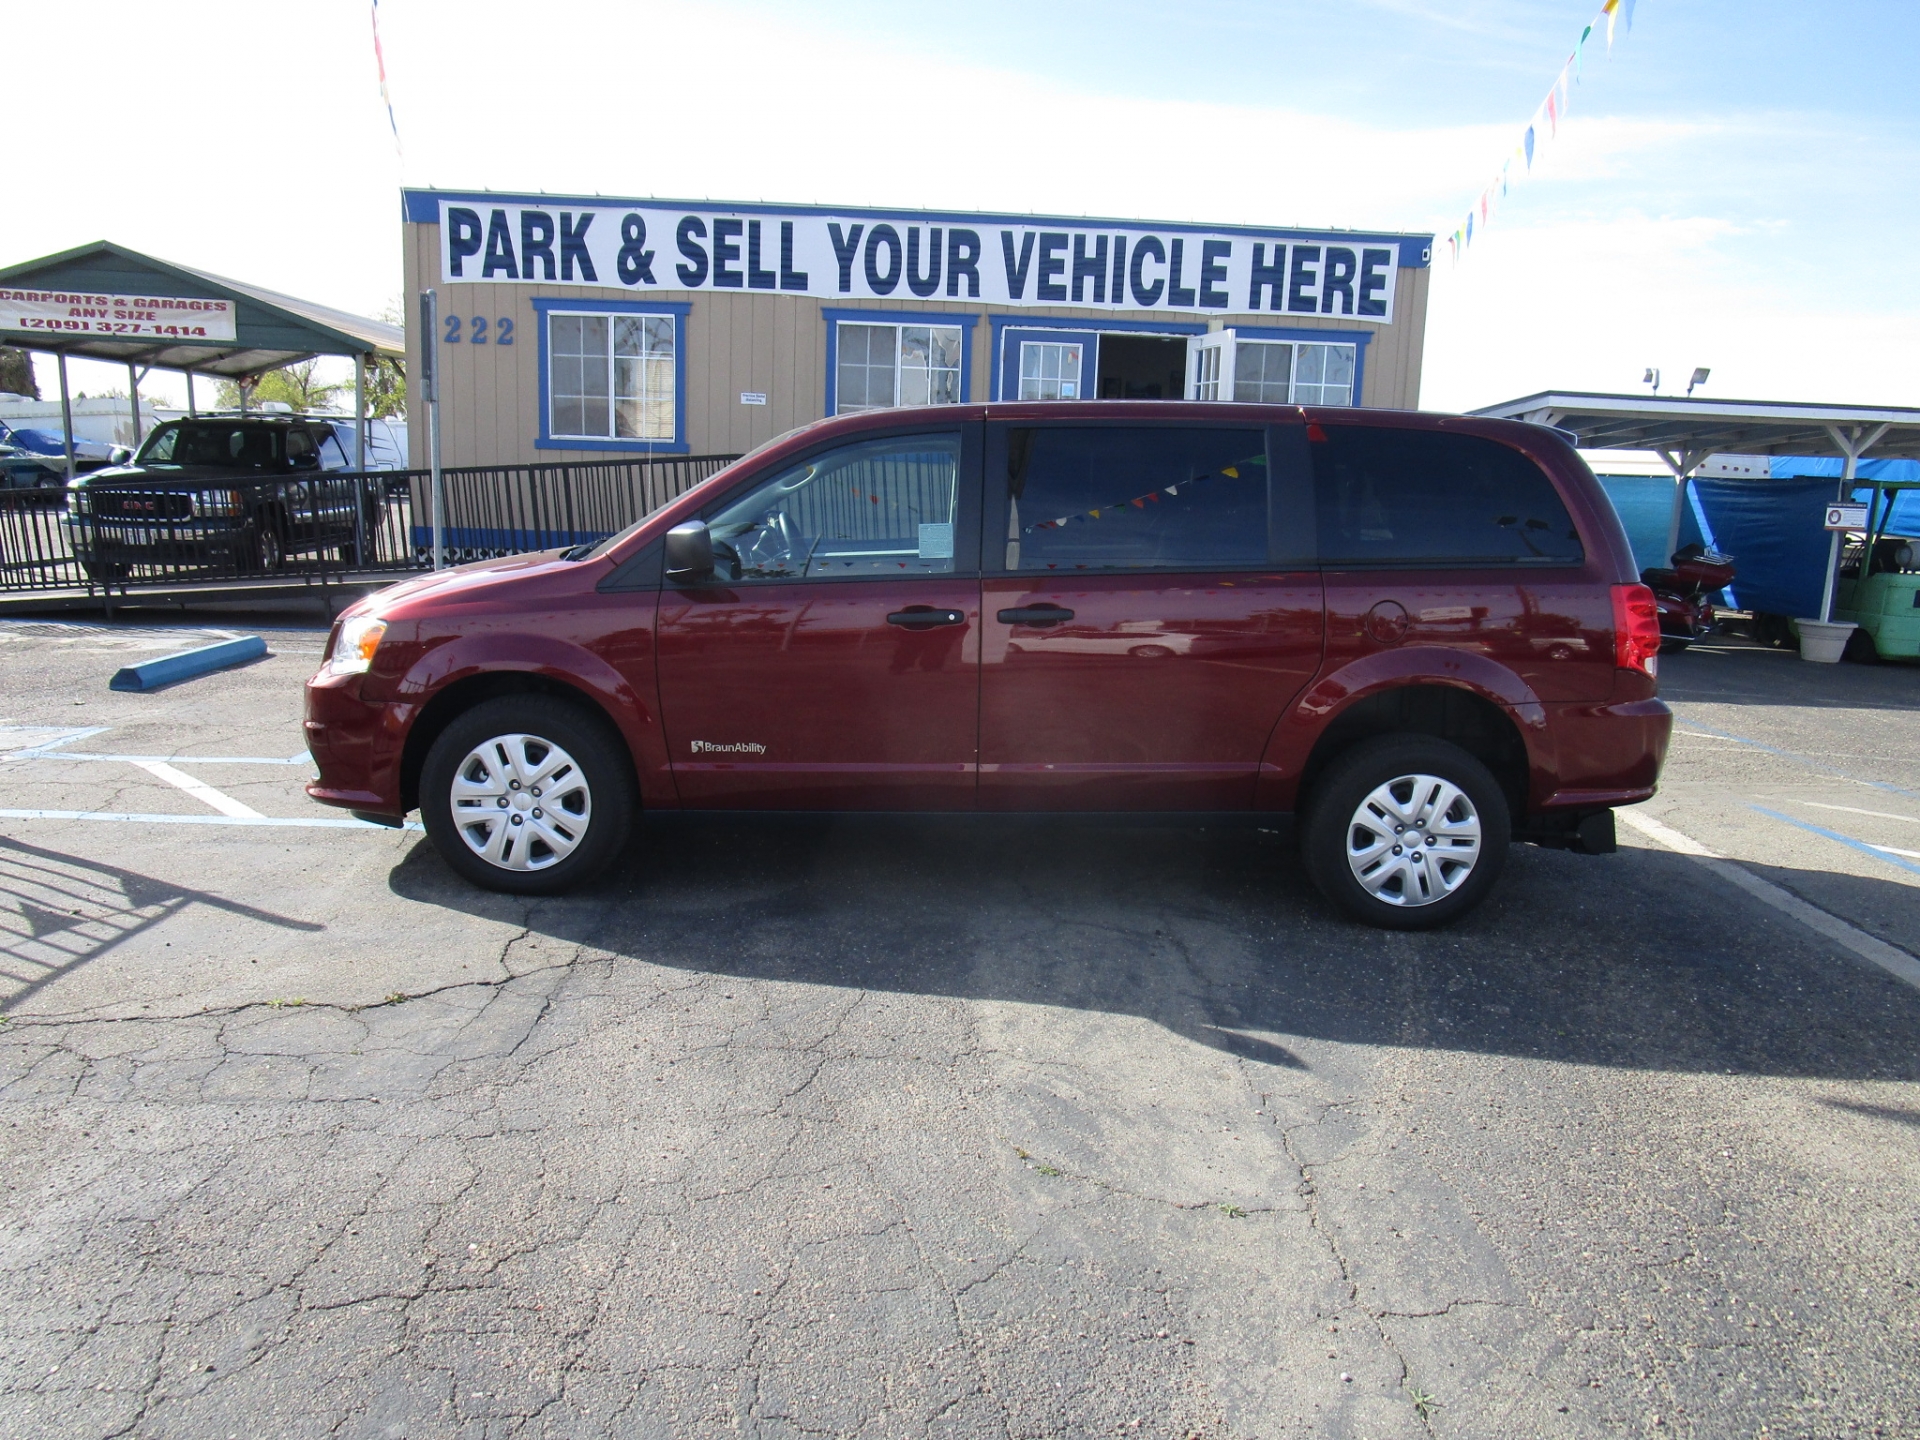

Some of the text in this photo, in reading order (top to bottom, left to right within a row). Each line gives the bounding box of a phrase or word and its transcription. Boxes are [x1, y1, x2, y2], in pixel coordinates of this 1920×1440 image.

[447, 207, 1391, 317] PARK & SELL YOUR VEHICLE HERE
[0, 290, 227, 311] CARPORTS & GARAGES
[68, 307, 156, 321] ANY SIZE
[96, 321, 207, 337] 327-1414
[704, 741, 767, 755] BraunAbility
